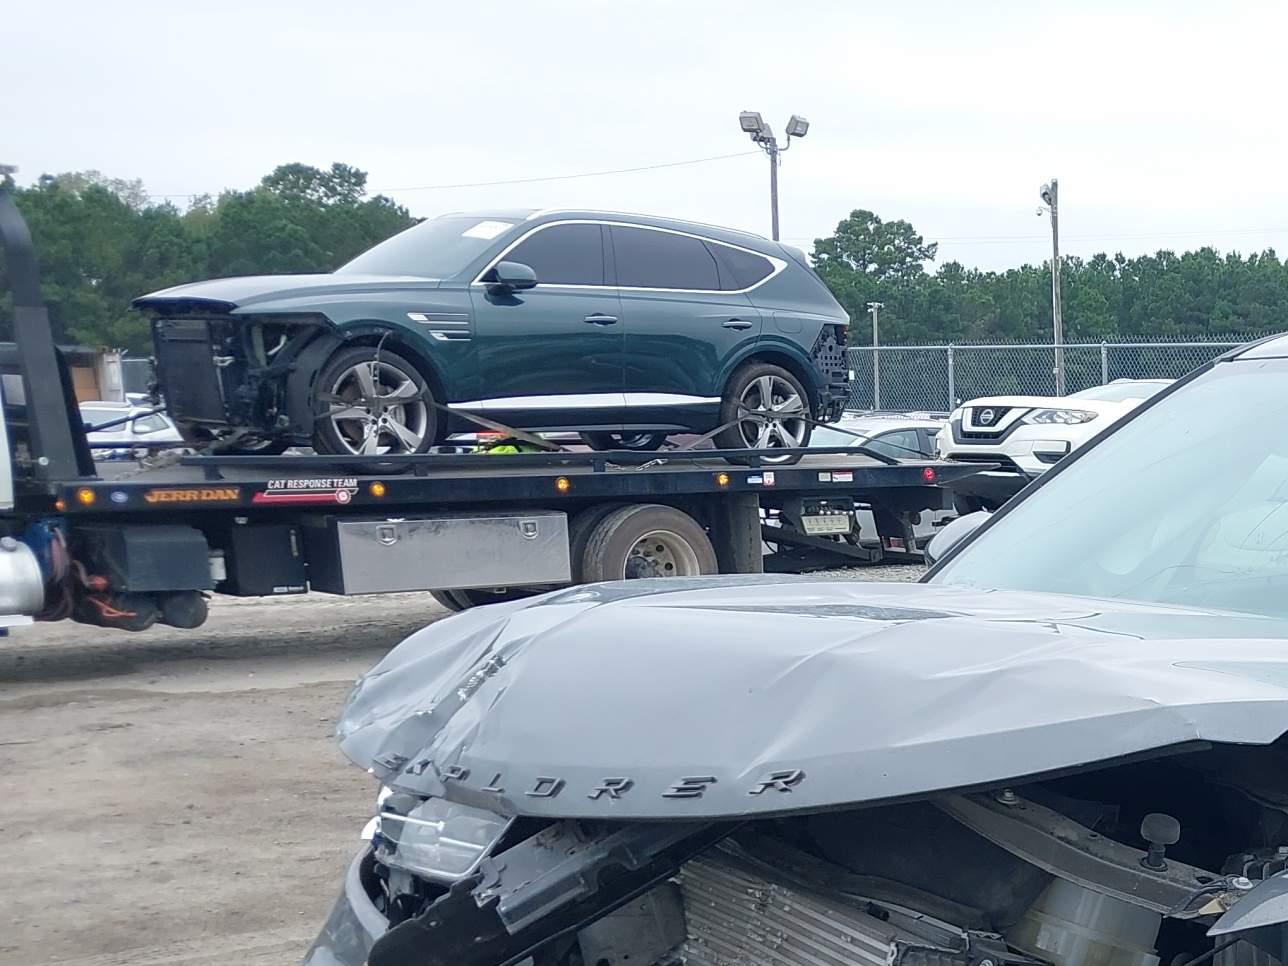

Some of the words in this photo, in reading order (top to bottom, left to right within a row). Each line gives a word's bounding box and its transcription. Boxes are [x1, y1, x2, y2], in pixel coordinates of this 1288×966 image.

[267, 480, 286, 489] CAT
[287, 479, 333, 489] RESPONSE
[333, 478, 358, 487] TEAM
